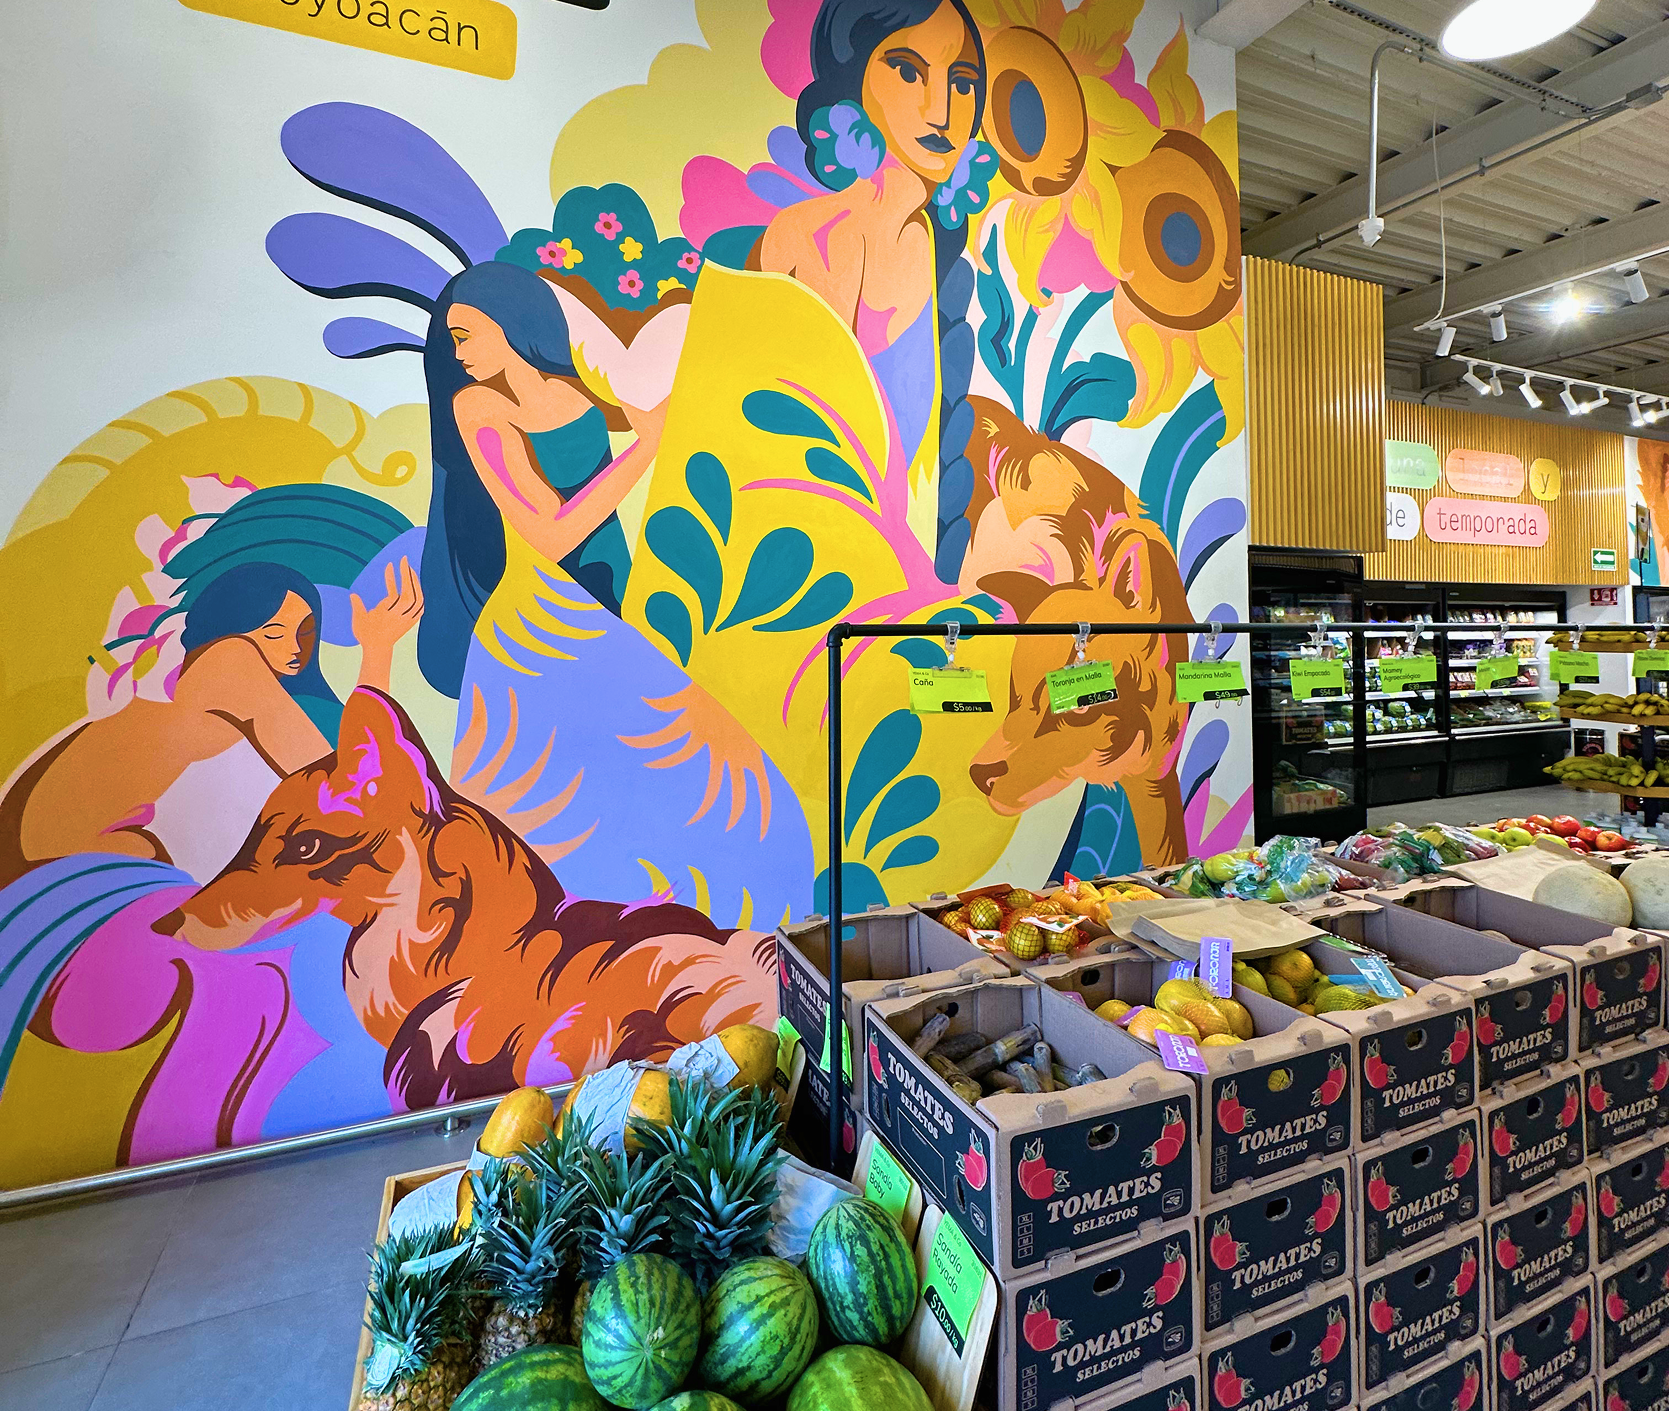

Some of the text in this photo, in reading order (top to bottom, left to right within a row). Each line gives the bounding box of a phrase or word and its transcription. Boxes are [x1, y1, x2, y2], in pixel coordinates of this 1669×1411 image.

[1540, 473, 1551, 494] y
[1387, 502, 1538, 538] de temporada
[913, 678, 934, 686] Caña
[1051, 677, 1075, 688] Toronja
[1085, 671, 1102, 681] Malla
[1178, 672, 1213, 680] Mandarina
[1304, 670, 1331, 678] Empacado
[1594, 996, 1648, 1026] TOMATES
[1490, 1028, 1553, 1062] TOMATES
[1504, 1051, 1540, 1071] SELECTOS
[888, 1052, 954, 1134] TOMATES
[1382, 1069, 1456, 1107] TOMATES
[901, 1092, 939, 1139] SELECTOS
[1398, 1095, 1441, 1118] SELECTOS
[1601, 1096, 1659, 1128] TOMATES
[1237, 1110, 1328, 1154] TOMATES
[1257, 1140, 1308, 1165] SELECTOS
[1506, 1132, 1569, 1173] TOMATES
[1520, 1157, 1556, 1180] SELECTOS
[869, 1172, 886, 1198] Baby
[872, 1159, 893, 1190] Sandía
[1047, 1171, 1163, 1223] TOMATES
[1385, 1183, 1460, 1229] TOMATES
[1612, 1193, 1667, 1232] TOMATES
[1073, 1206, 1138, 1235] SELECTOS
[1402, 1211, 1444, 1237] SELECTOS
[937, 1232, 963, 1274] Sandía
[1231, 1238, 1322, 1290] TOMATES
[1511, 1241, 1574, 1286] TOMATES
[933, 1248, 959, 1294] Rayada
[1251, 1270, 1303, 1298] SELECTOS
[1525, 1268, 1561, 1293] SELECTOS
[1051, 1311, 1164, 1373] TOMATES
[1387, 1301, 1461, 1351] TOMATES
[1403, 1330, 1446, 1359] SELECTOS
[1076, 1347, 1141, 1382] SELECTOS
[1515, 1346, 1577, 1396] TOMATES
